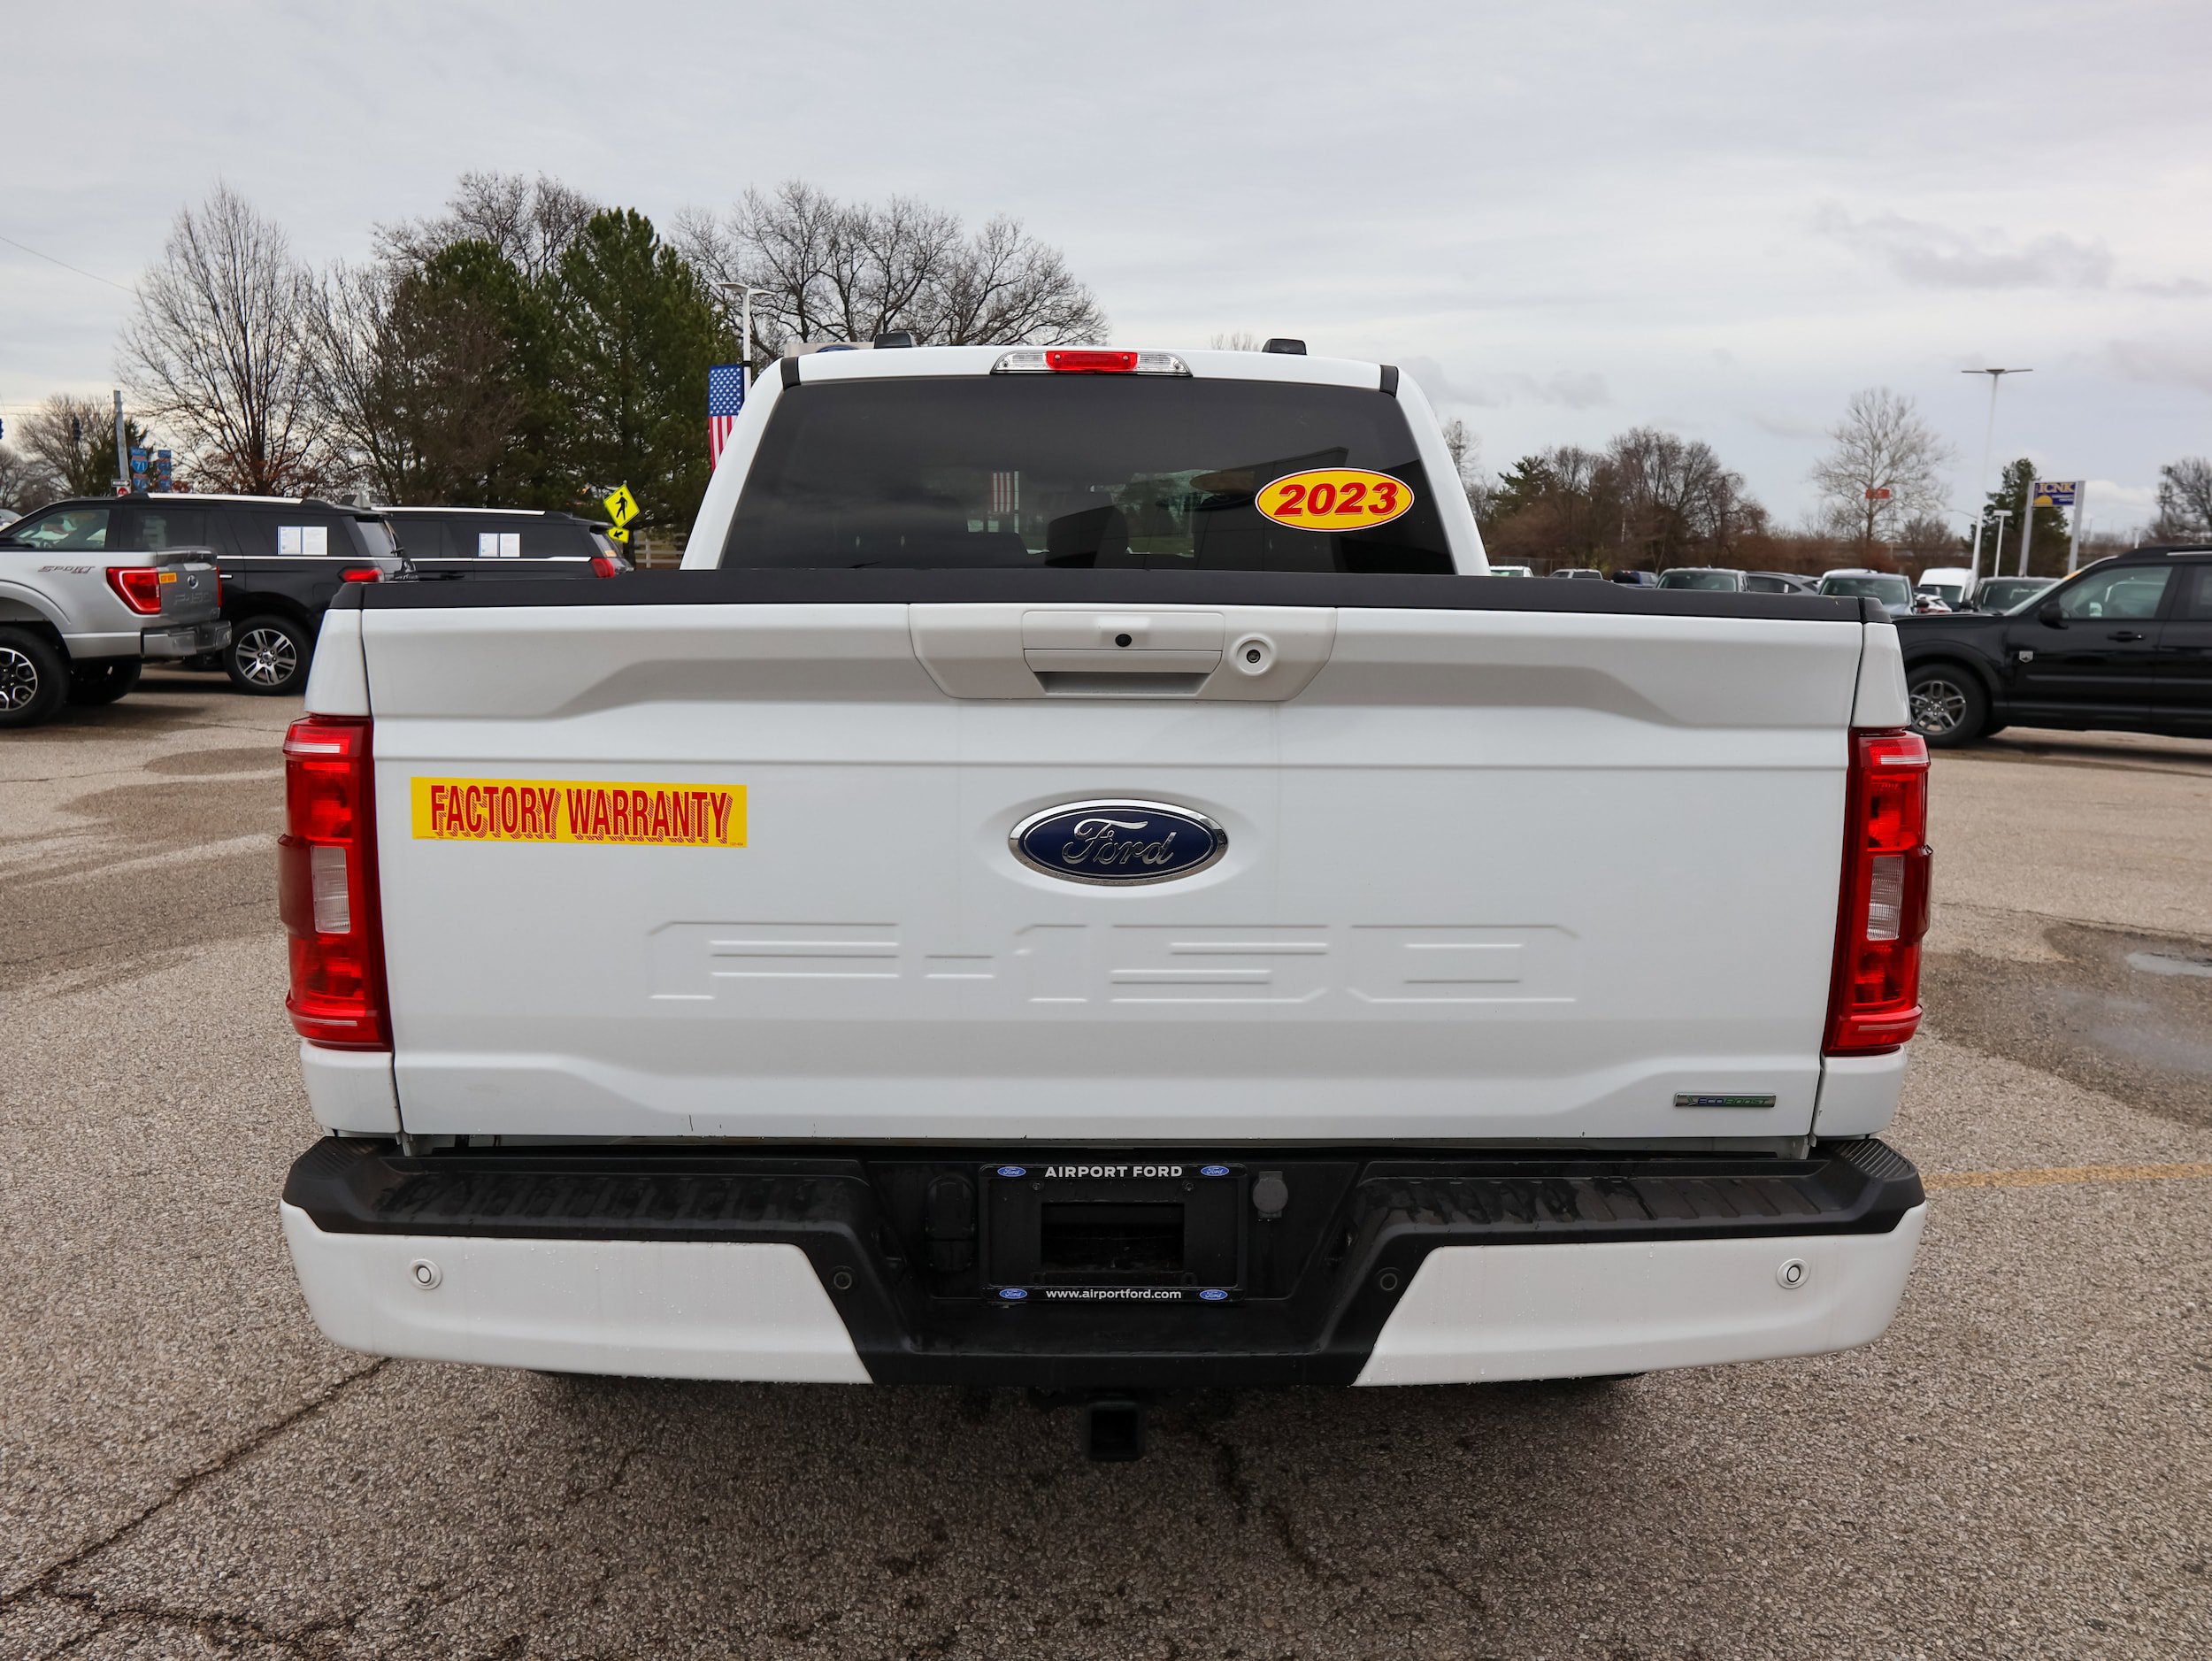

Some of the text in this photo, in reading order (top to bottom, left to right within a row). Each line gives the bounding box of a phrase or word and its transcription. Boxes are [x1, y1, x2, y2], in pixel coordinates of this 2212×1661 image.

[134, 462, 145, 471] 71
[2039, 483, 2075, 493] ICNK
[1273, 482, 1400, 517] 2023
[431, 785, 733, 844] FACTORY WARRANTY
[1061, 817, 1179, 865] Ford
[1002, 1166, 1022, 1176] Ford
[1045, 1165, 1183, 1178] AIRPORT FORD
[1204, 1166, 1226, 1175] Ford
[1002, 1289, 1025, 1298] Ford
[1046, 1289, 1182, 1300] www.airportford.com
[1203, 1289, 1225, 1299] Ford
